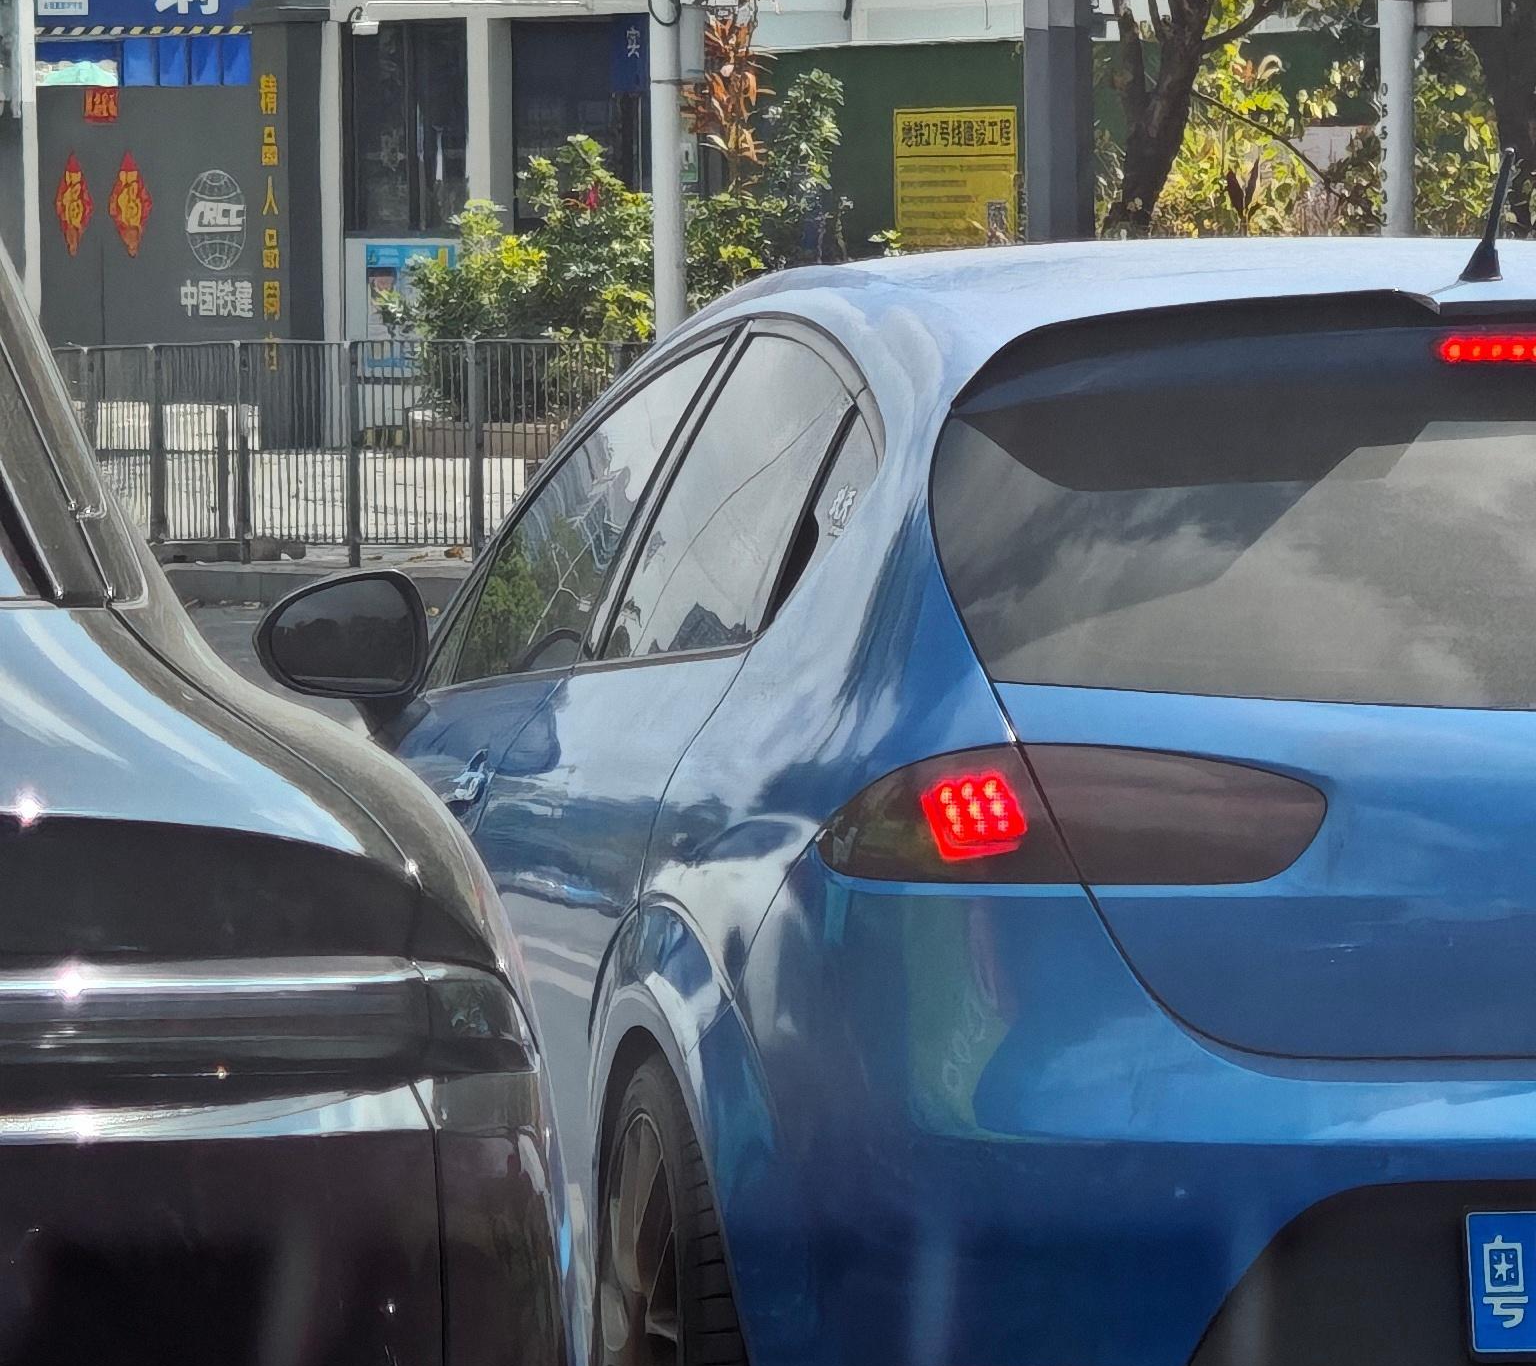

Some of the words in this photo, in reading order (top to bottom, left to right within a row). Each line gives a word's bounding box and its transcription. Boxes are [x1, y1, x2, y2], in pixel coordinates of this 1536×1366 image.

[186, 200, 246, 234] CRCC
[180, 278, 254, 318] 中国铁建
